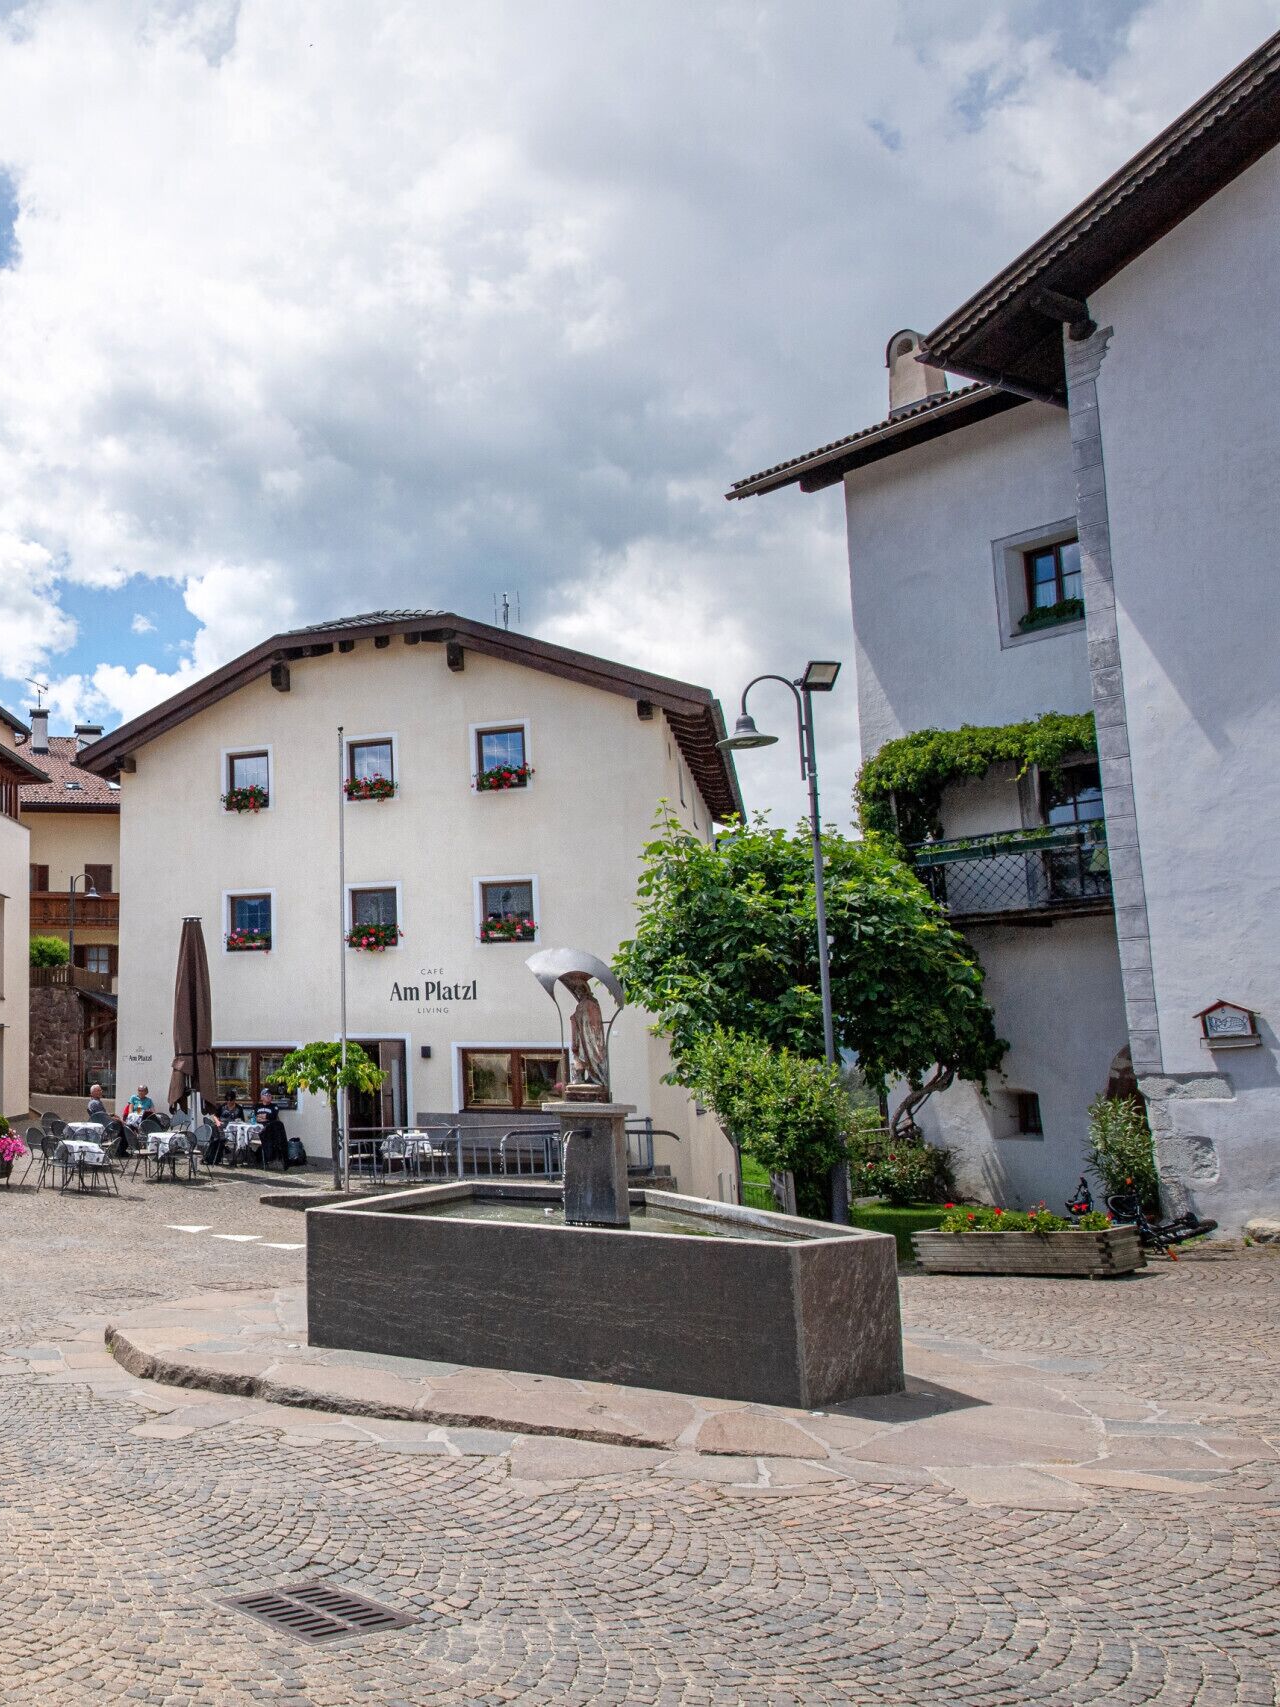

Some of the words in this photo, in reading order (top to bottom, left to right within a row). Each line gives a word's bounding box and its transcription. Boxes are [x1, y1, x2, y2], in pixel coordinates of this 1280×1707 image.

[420, 967, 444, 975] CAFÉ
[390, 981, 420, 1001] Am
[425, 980, 477, 1001] Platzl
